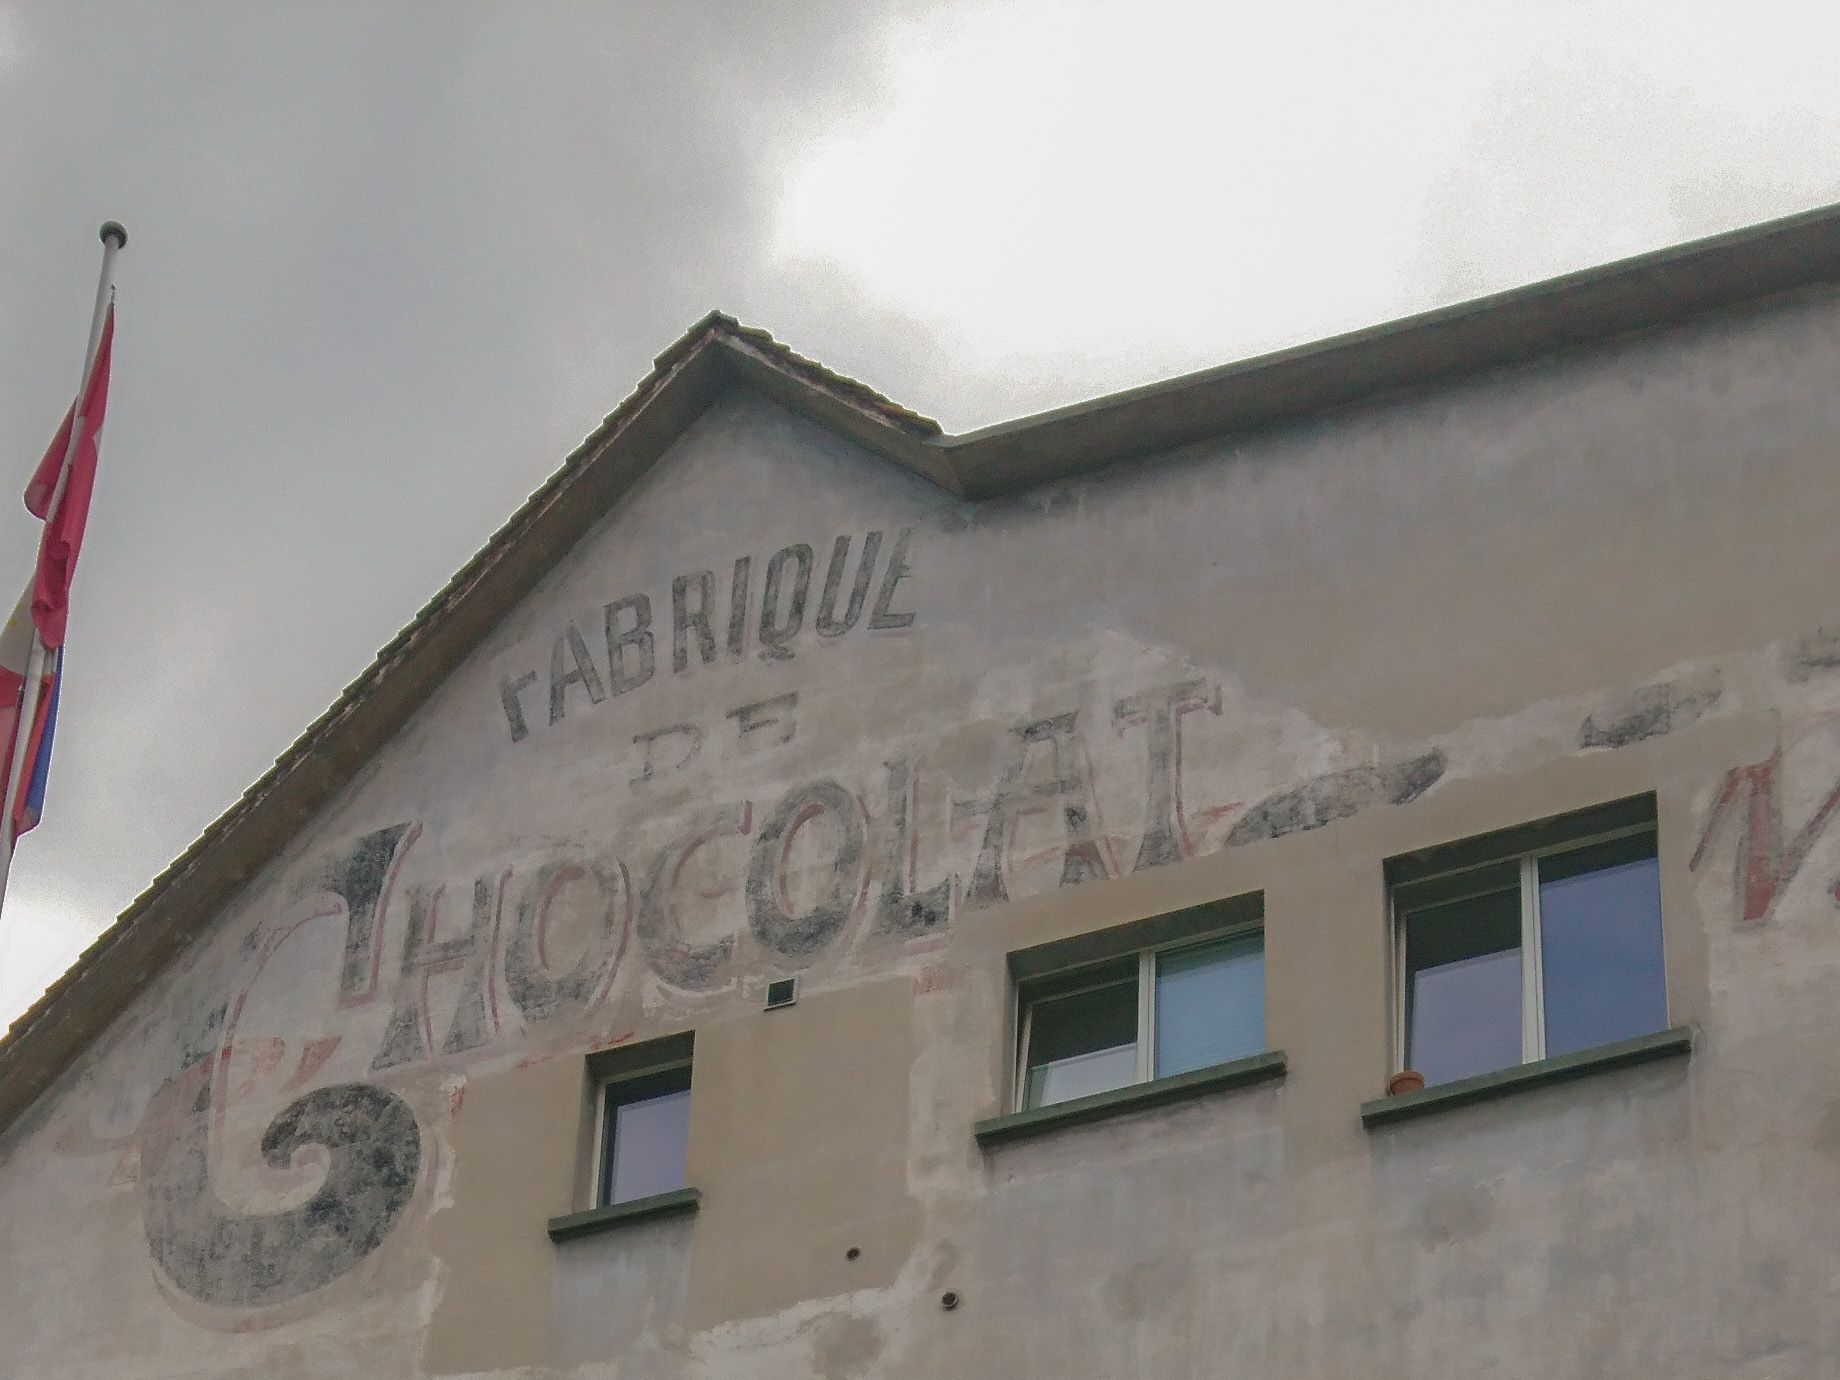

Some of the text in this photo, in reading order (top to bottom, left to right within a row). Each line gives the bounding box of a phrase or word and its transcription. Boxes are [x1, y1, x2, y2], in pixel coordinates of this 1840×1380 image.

[498, 526, 918, 744] FABRIQUE
[628, 691, 800, 787] DE
[138, 674, 1224, 1334] CHOCOLAT
